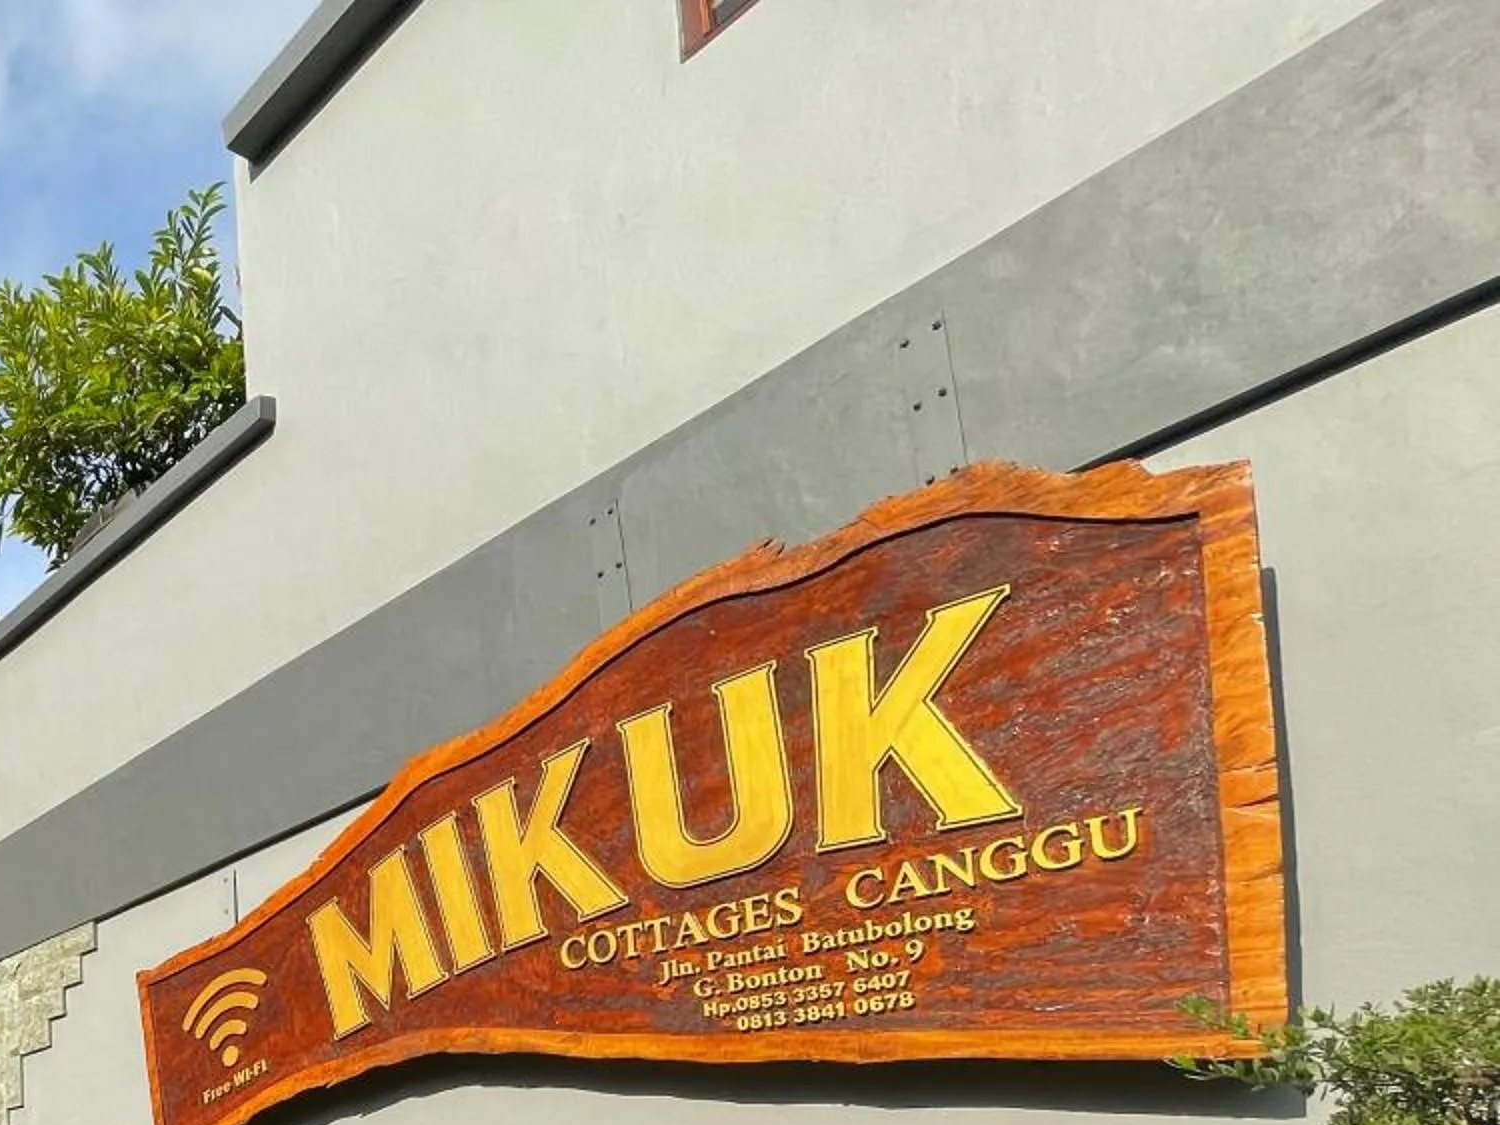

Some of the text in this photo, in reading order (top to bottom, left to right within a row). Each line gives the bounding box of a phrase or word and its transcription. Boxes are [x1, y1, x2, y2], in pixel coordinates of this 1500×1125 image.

[306, 584, 1024, 1041] MIKUK
[560, 807, 1143, 969] COTTAGES CANGGU
[658, 907, 976, 985] Jln. Pantai Batubolong
[693, 939, 925, 998] G. Bonton No. 9
[737, 991, 916, 1031] 0813 3841 0678
[792, 981, 846, 1004] 3357
[853, 969, 911, 993] 6407
[202, 1081, 231, 1105] Free
